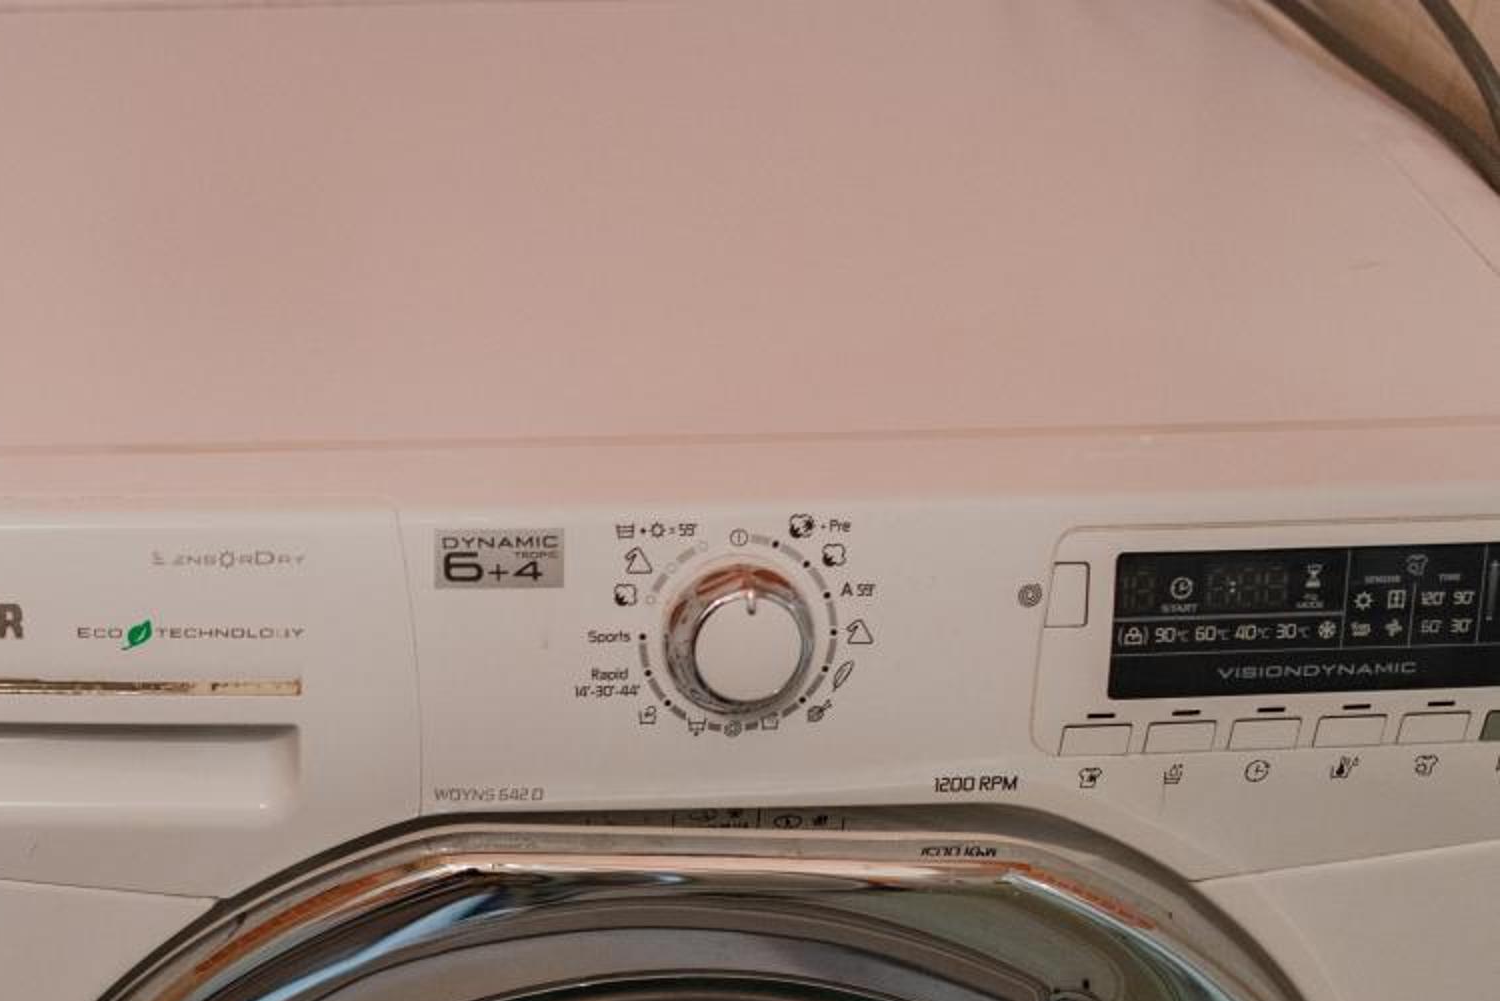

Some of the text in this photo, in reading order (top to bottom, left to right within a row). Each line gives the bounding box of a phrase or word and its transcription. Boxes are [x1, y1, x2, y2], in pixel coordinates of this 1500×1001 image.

[829, 519, 851, 532] Pre
[441, 535, 559, 550] DYNAMIC
[443, 551, 543, 582] 6+4
[840, 581, 853, 596] A
[77, 627, 123, 639] ECO
[587, 629, 631, 645] Sports
[591, 667, 629, 682] Rapid
[1217, 661, 1418, 680] VISIONDYNAMIC
[934, 775, 1018, 792] 1200 RPM
